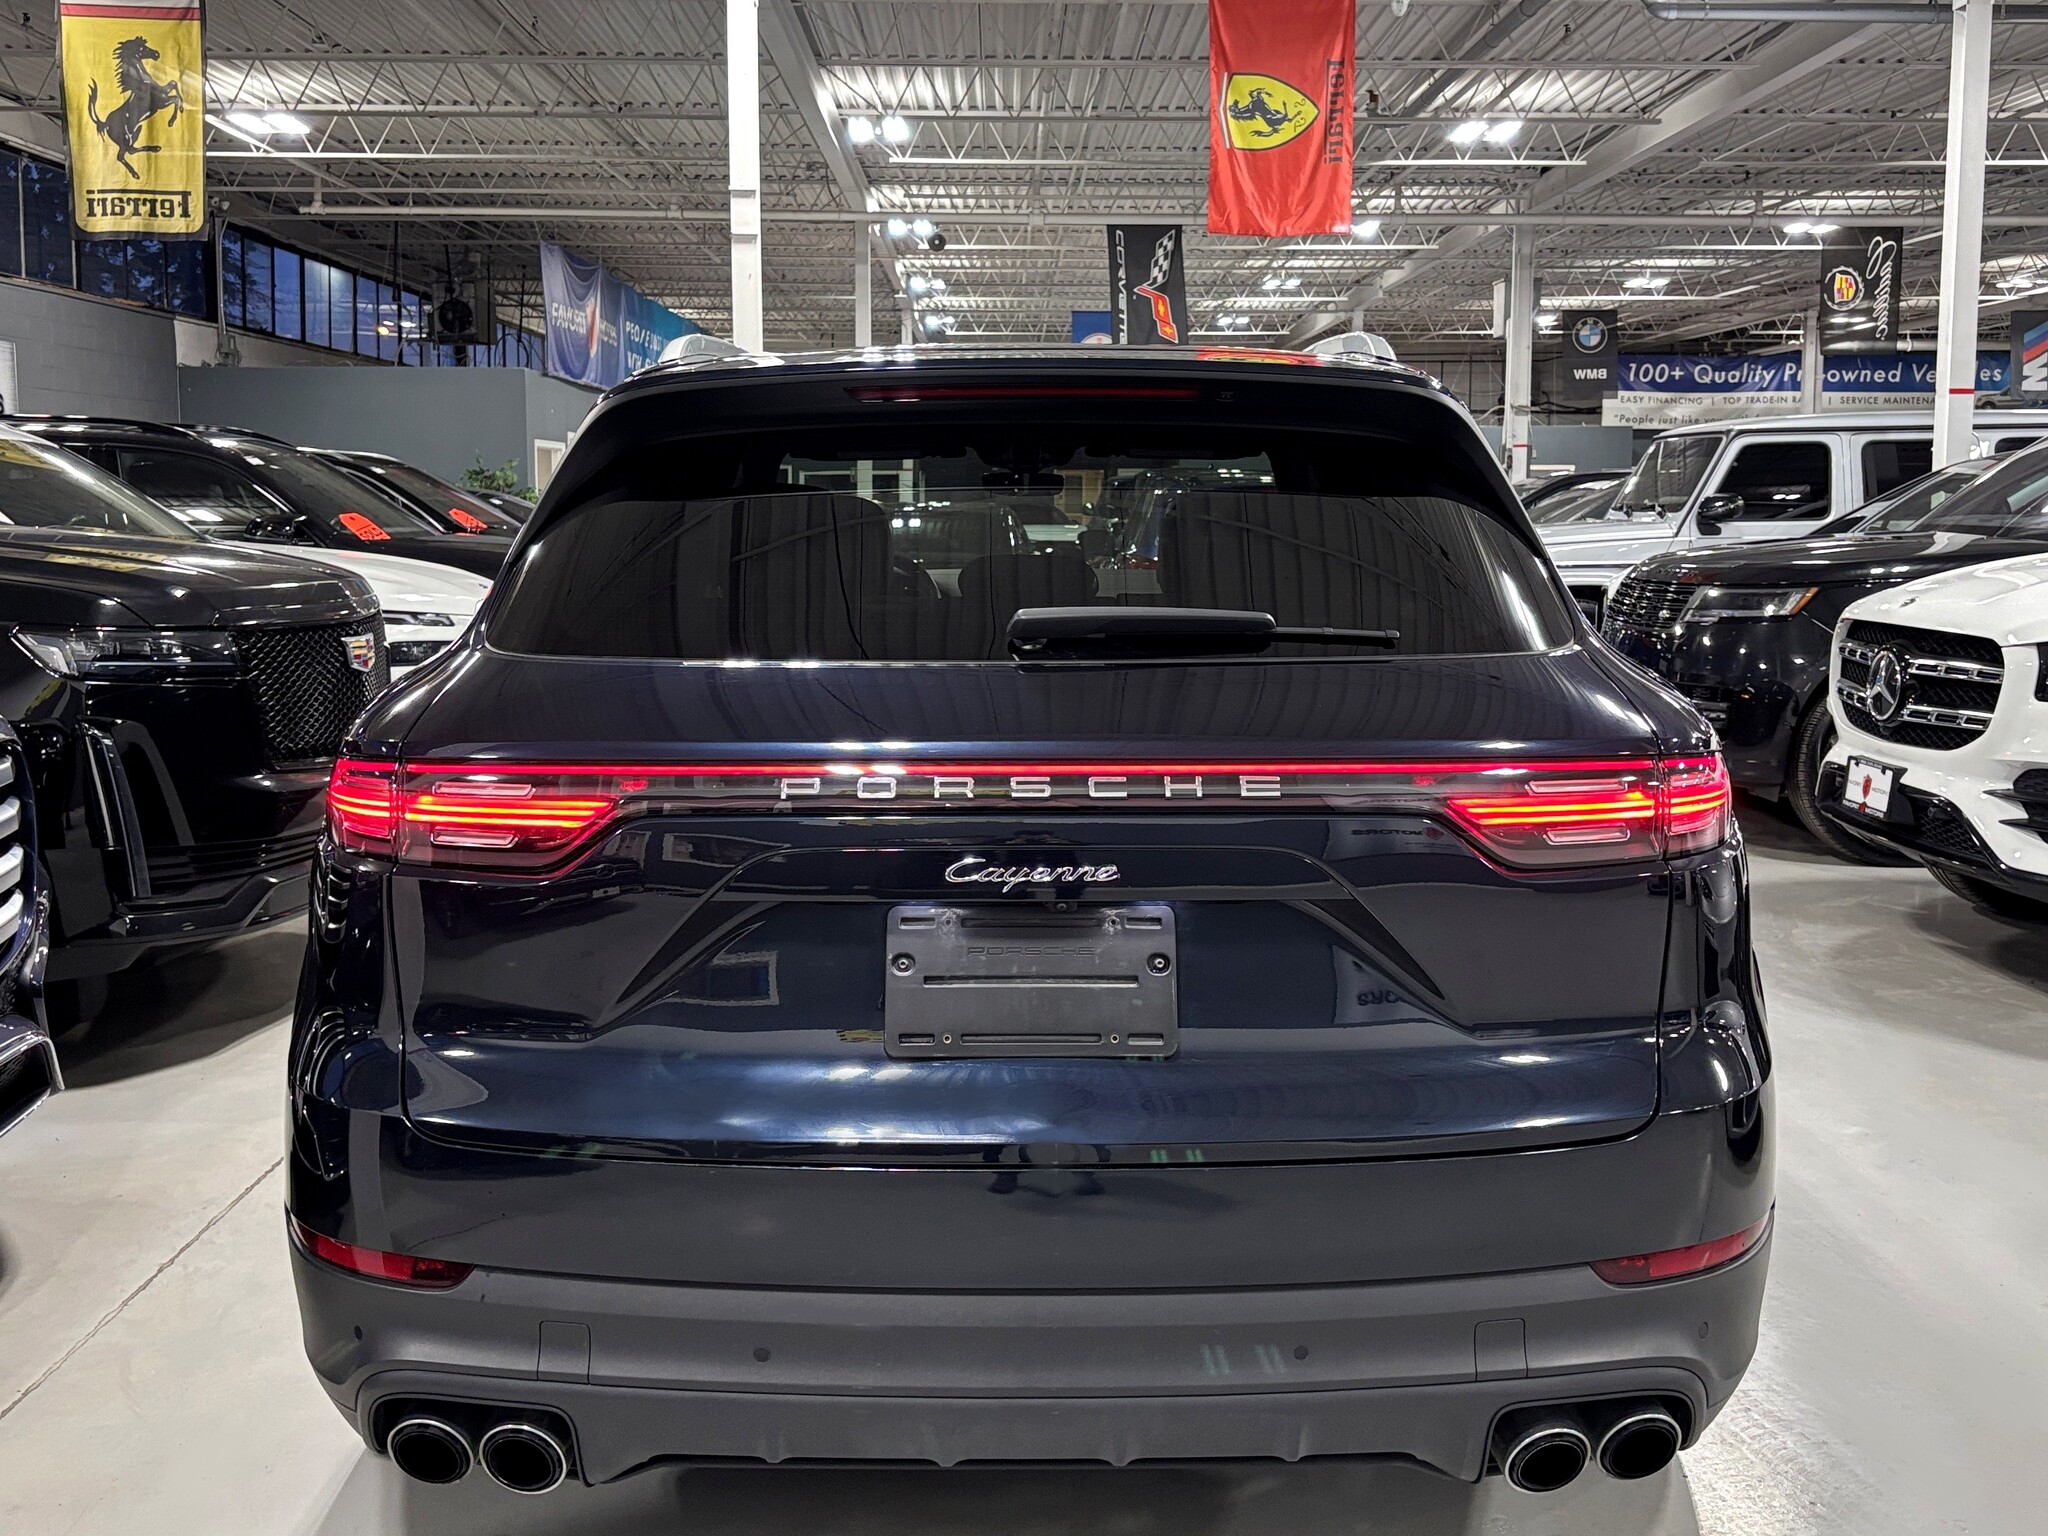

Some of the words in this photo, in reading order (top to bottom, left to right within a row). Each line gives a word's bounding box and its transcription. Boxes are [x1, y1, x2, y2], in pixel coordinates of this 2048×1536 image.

[1627, 362, 1684, 384] 100+
[1694, 362, 1776, 389] Quality
[1620, 395, 1644, 404] EASY
[1648, 396, 1703, 405] FINANCING
[1723, 396, 1742, 405] TOP
[1745, 395, 1788, 404] TRADE-IN
[1840, 396, 1879, 405] SERVICE
[1882, 396, 1935, 405] MAINTENA
[1658, 414, 1678, 425] just
[1681, 414, 1700, 424] like
[781, 776, 1283, 800] PORSCHE
[945, 857, 1121, 893] Cayenne
[968, 946, 1095, 957] PORSCHE
